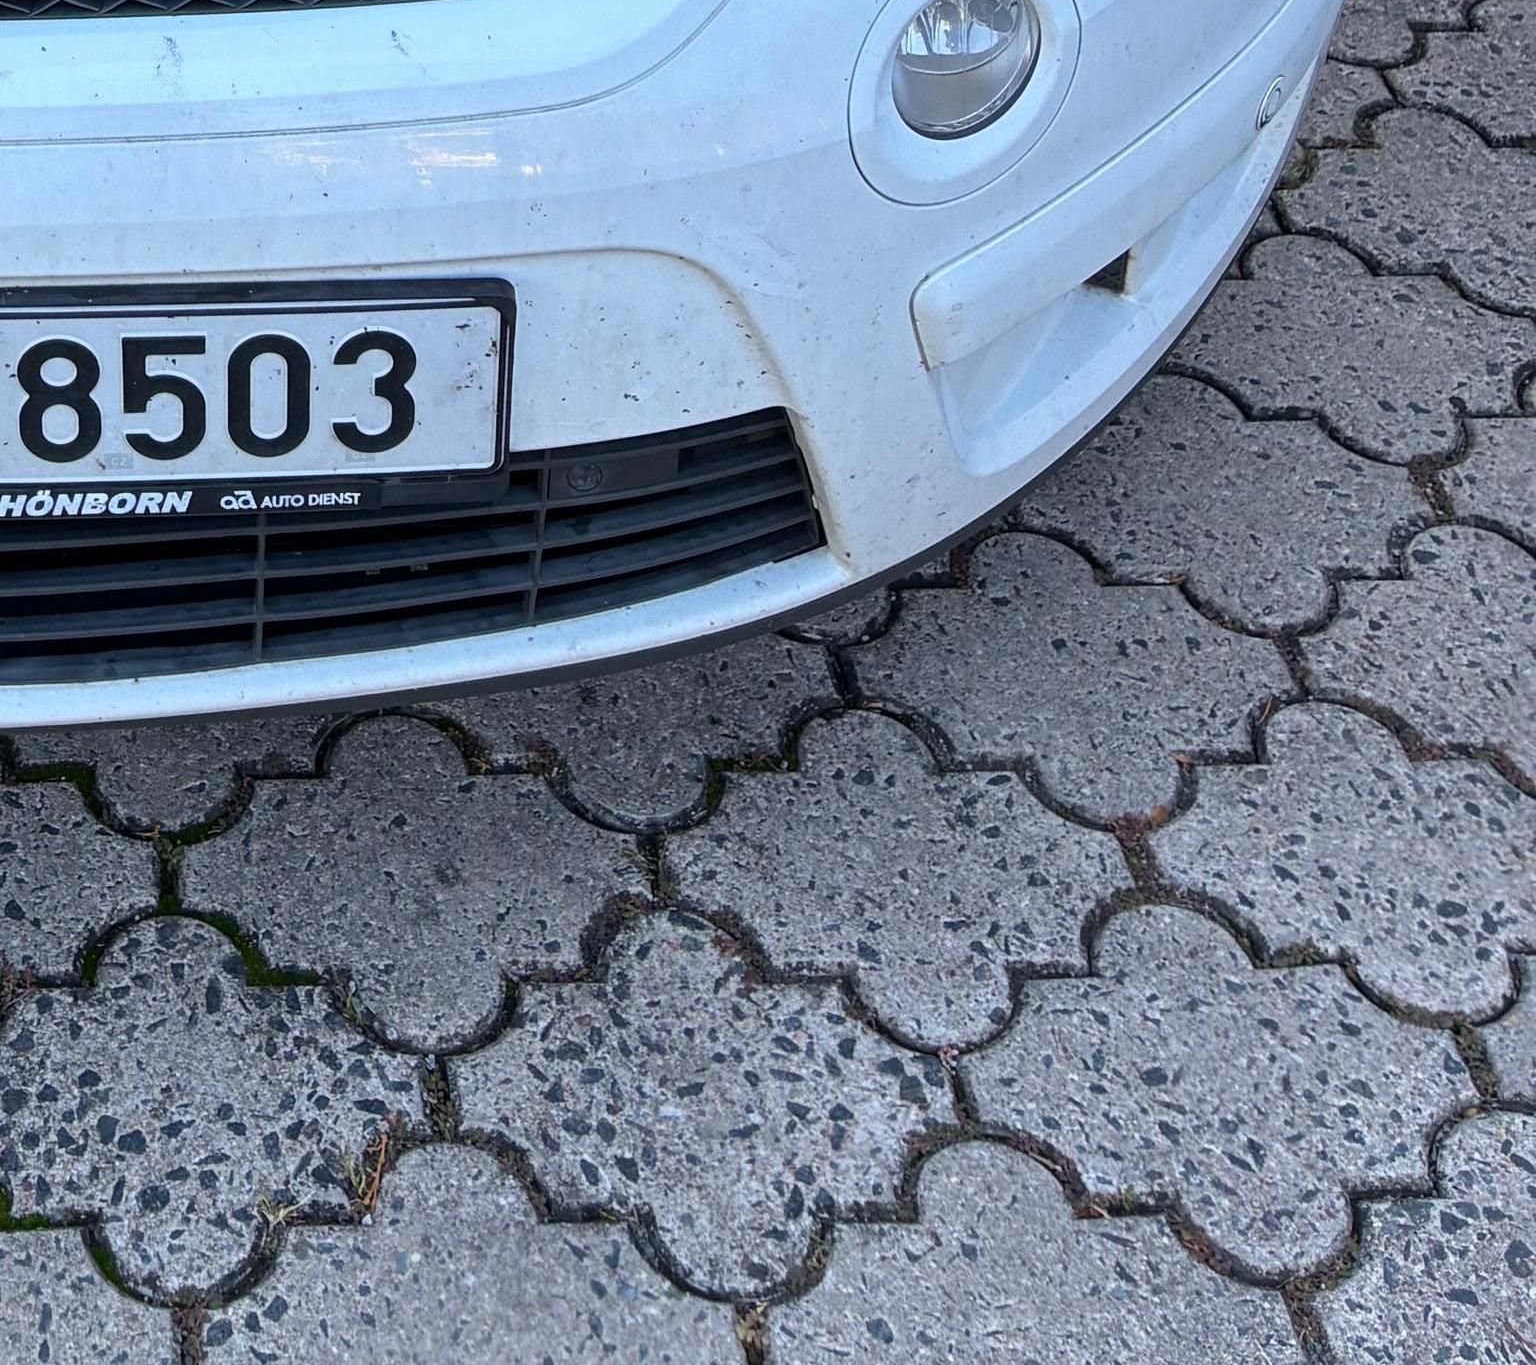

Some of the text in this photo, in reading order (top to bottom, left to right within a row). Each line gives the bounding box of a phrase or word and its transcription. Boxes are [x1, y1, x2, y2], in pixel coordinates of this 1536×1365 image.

[16, 329, 417, 463] 8503
[260, 494, 305, 509] AUTO
[308, 492, 362, 507] DIENST
